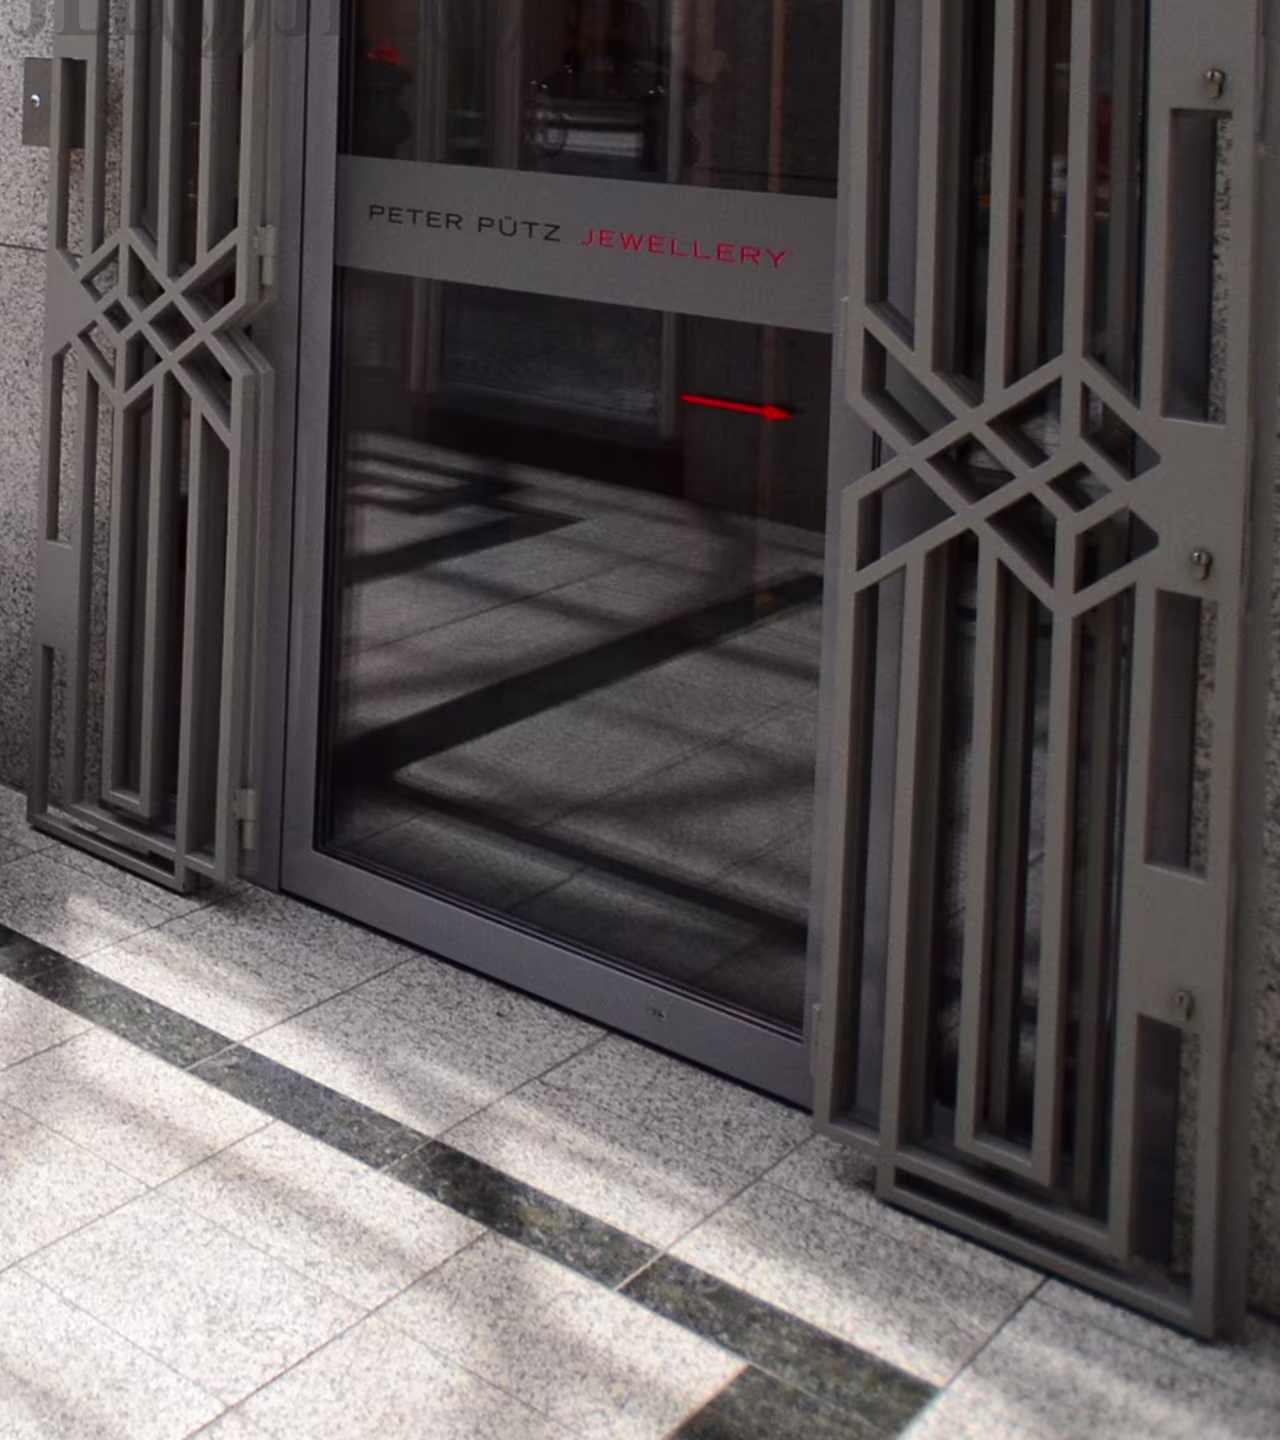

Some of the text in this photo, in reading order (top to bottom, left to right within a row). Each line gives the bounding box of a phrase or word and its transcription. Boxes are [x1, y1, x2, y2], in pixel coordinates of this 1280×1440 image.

[368, 204, 789, 267] PETER PÜTZ JEWELLERY
